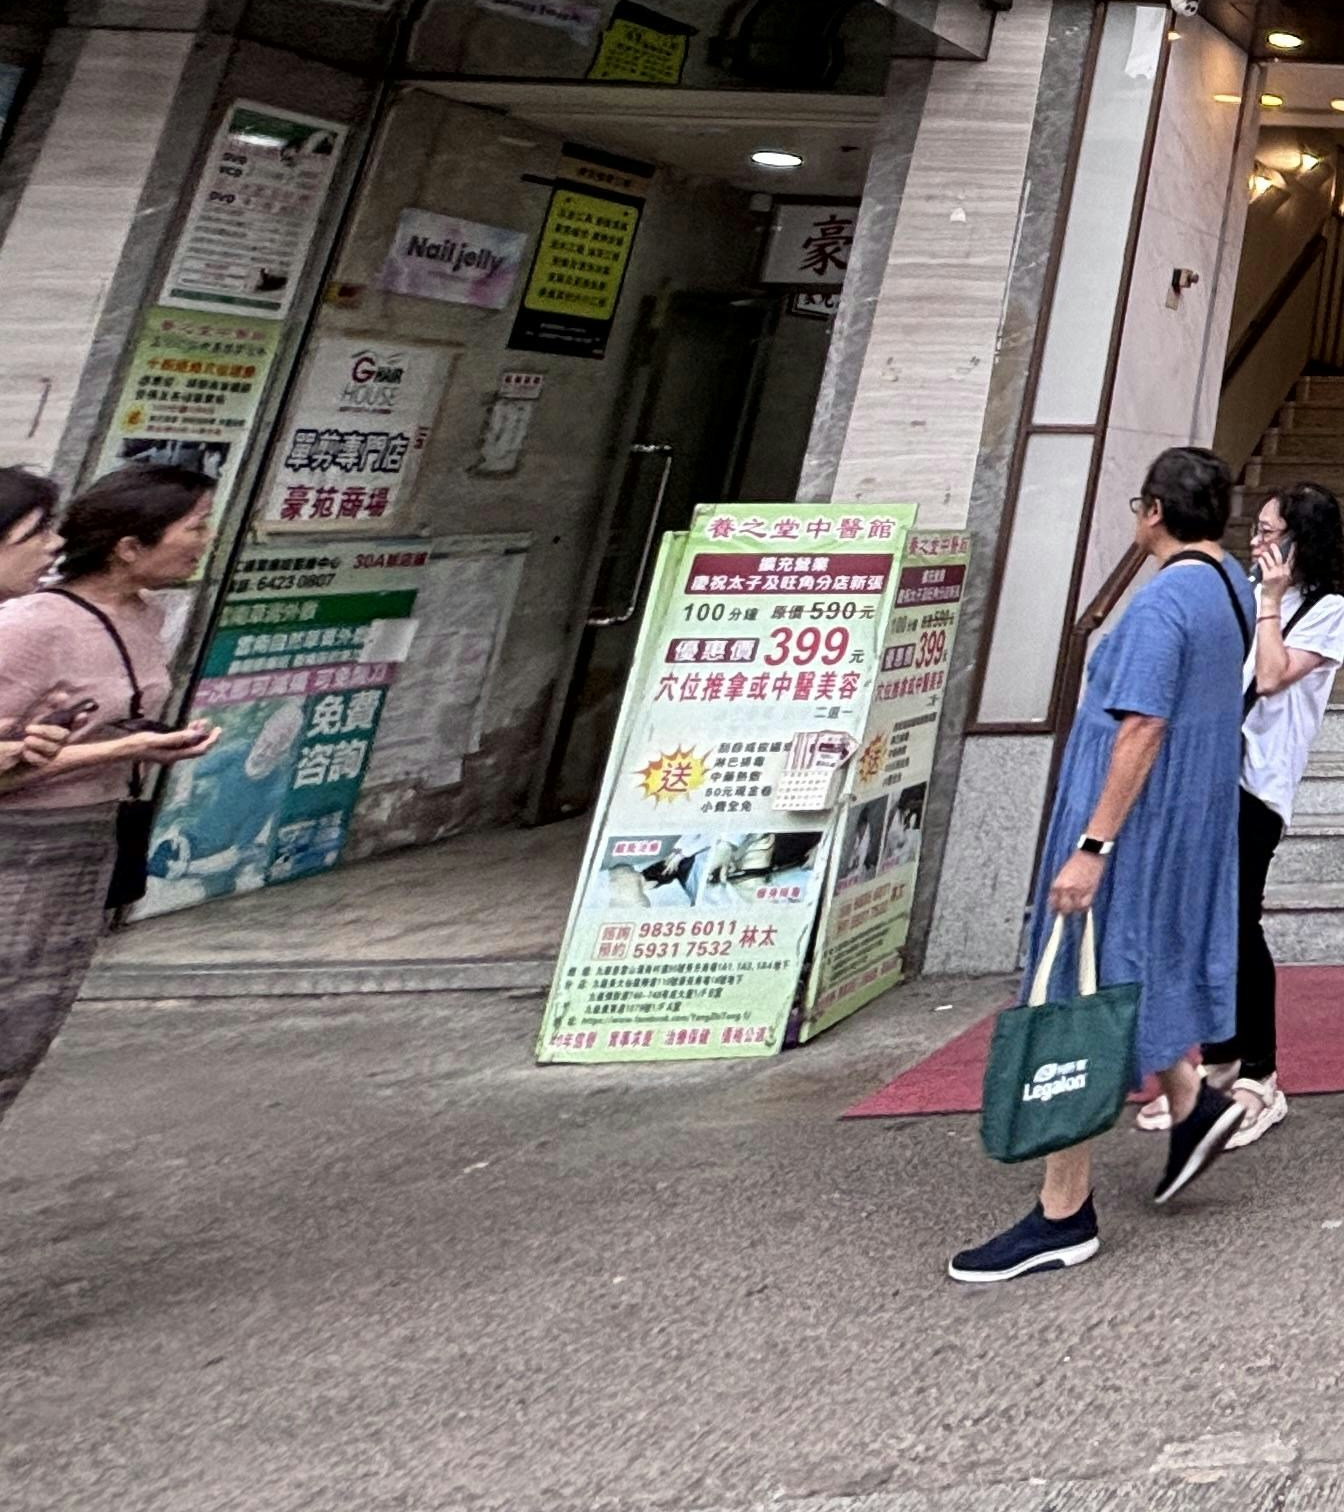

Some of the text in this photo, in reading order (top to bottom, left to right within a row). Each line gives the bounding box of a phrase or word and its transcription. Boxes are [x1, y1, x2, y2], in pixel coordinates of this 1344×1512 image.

[407, 235, 506, 279] Nail jelly
[799, 215, 853, 275] 豪
[280, 484, 391, 520] 豪苑商場
[708, 516, 897, 541] 養之堂中醫館
[758, 557, 829, 573] 擴充營業
[690, 574, 883, 593] 慶祝太子及旺角分店新張
[670, 640, 756, 662] 優惠價
[655, 670, 862, 702] 穴位推拿或中醫美容
[308, 690, 380, 737] 免費
[655, 759, 693, 794] 送
[638, 919, 738, 938] 9835 6011
[738, 924, 777, 948] 林太
[632, 938, 733, 958] 5931 7532
